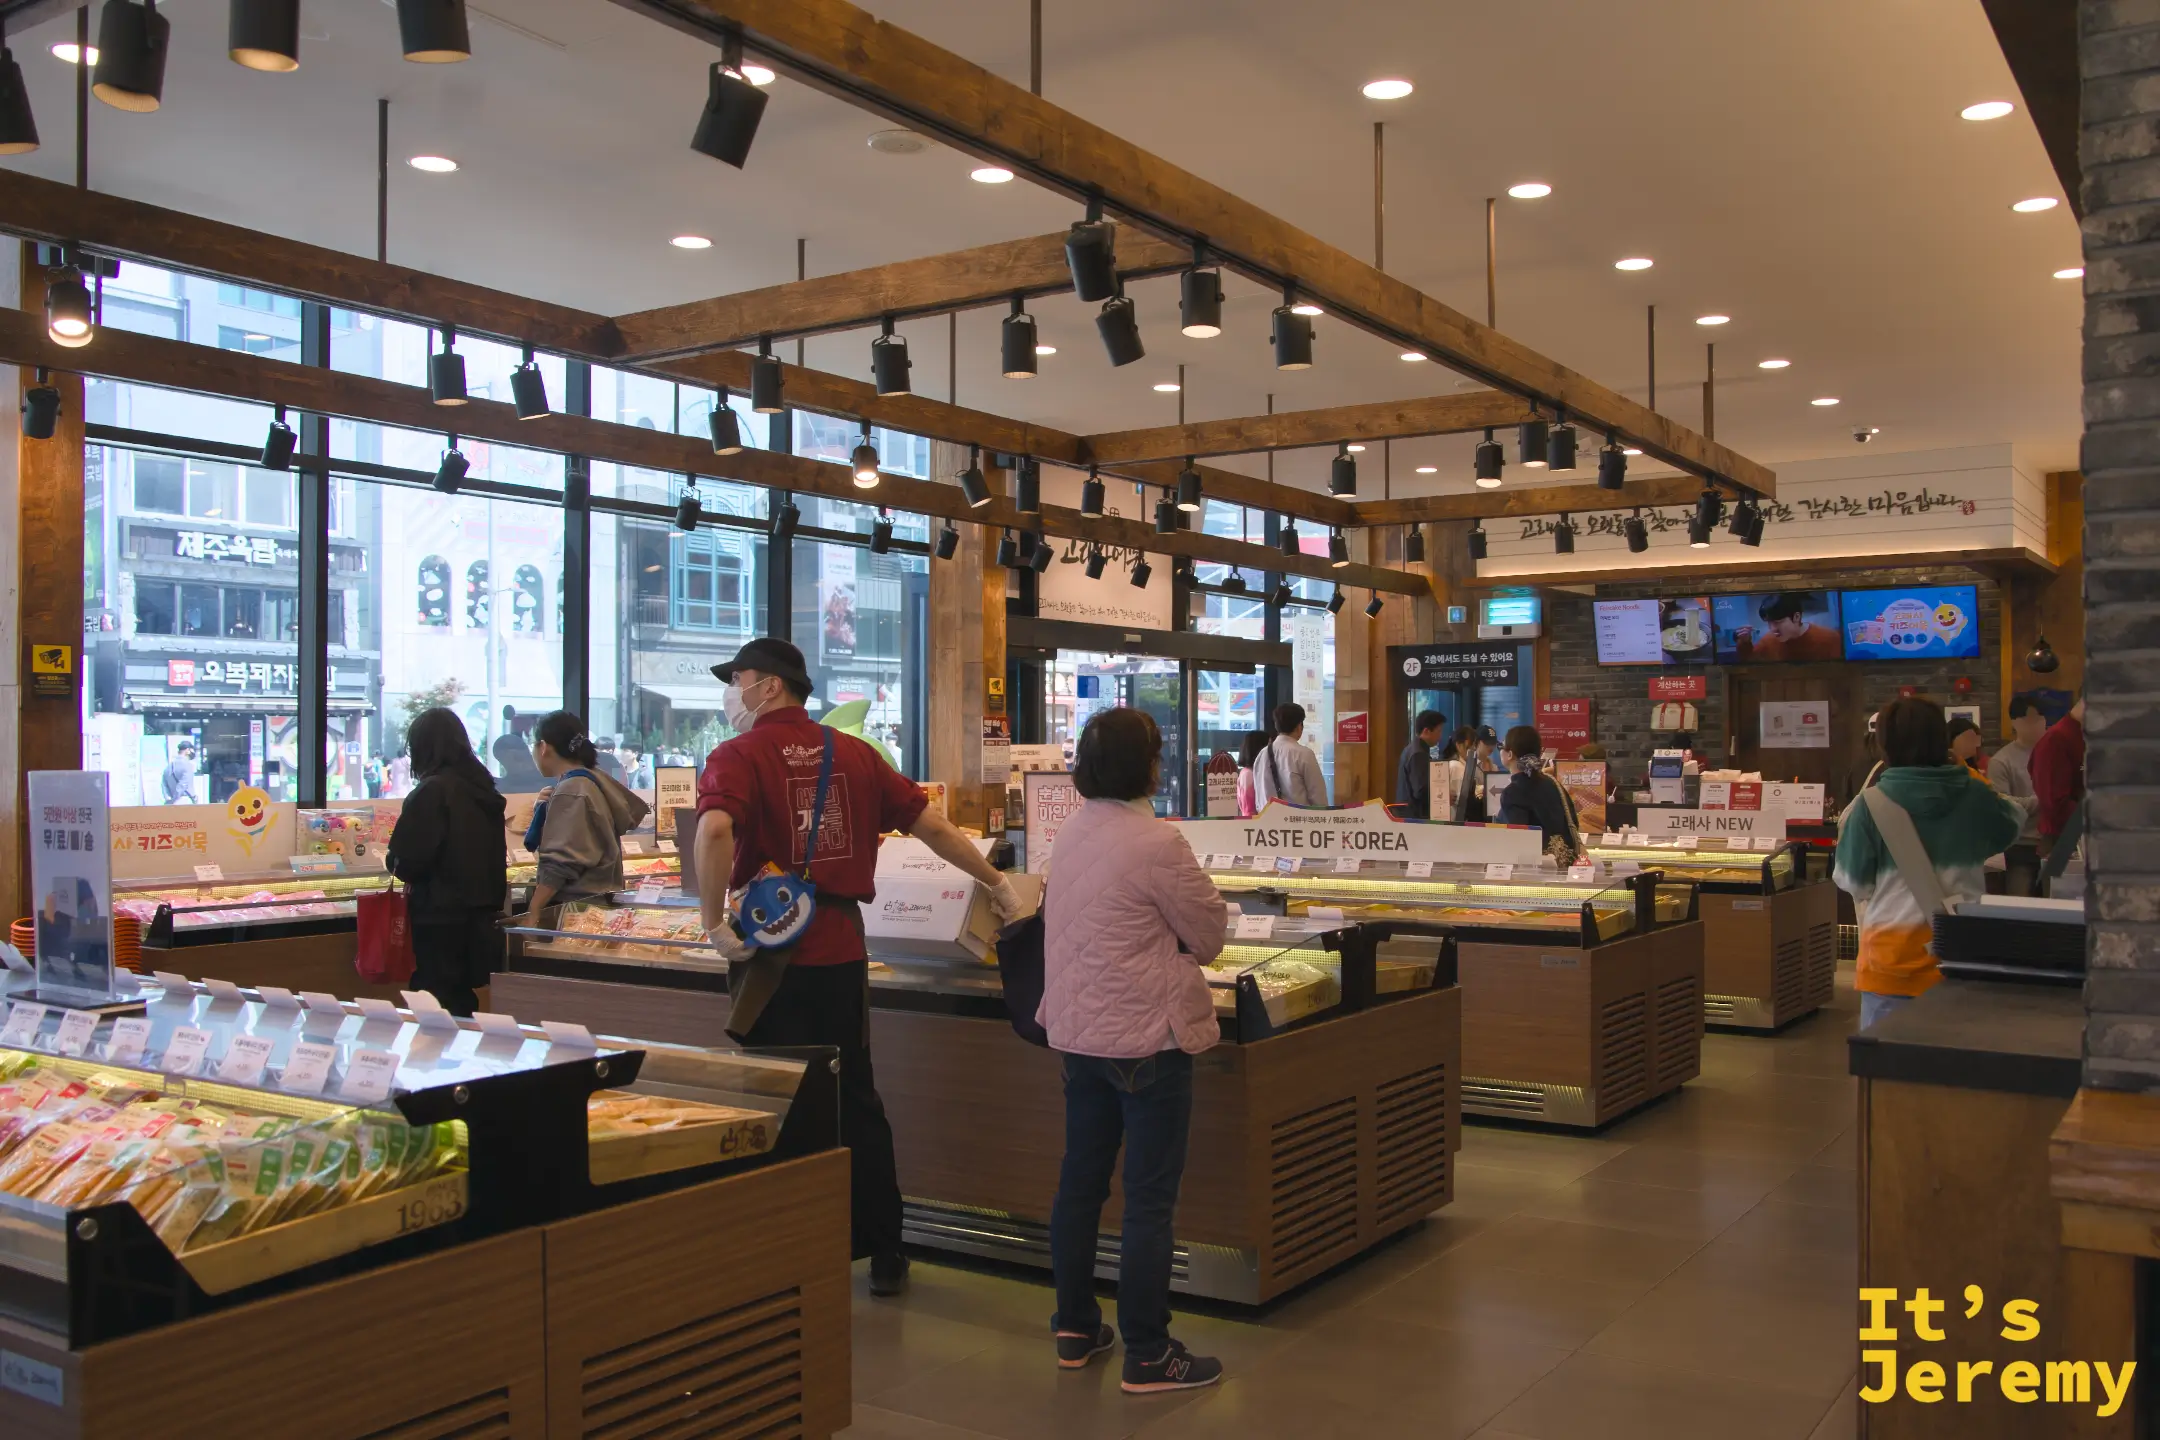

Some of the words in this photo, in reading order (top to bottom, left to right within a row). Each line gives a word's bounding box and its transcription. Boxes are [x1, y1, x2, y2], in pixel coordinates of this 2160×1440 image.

[1798, 496, 1867, 519] 감사한
[1868, 488, 1962, 516] 마음입니다
[1406, 662, 1419, 673] 2F
[1424, 654, 1460, 664] 2층에서도
[1462, 653, 1478, 663] 드실
[1480, 653, 1488, 662] 수
[1490, 652, 1514, 662] 있어요
[1657, 680, 1686, 689] 계산하는
[1667, 815, 1711, 832] 고래사
[1716, 817, 1753, 831] NEW
[137, 831, 208, 853] 키즈어묵
[1244, 829, 1303, 848] TASTE
[1310, 830, 1335, 849] OF
[1341, 831, 1409, 851] KOREA
[1165, 1357, 1190, 1380] N
